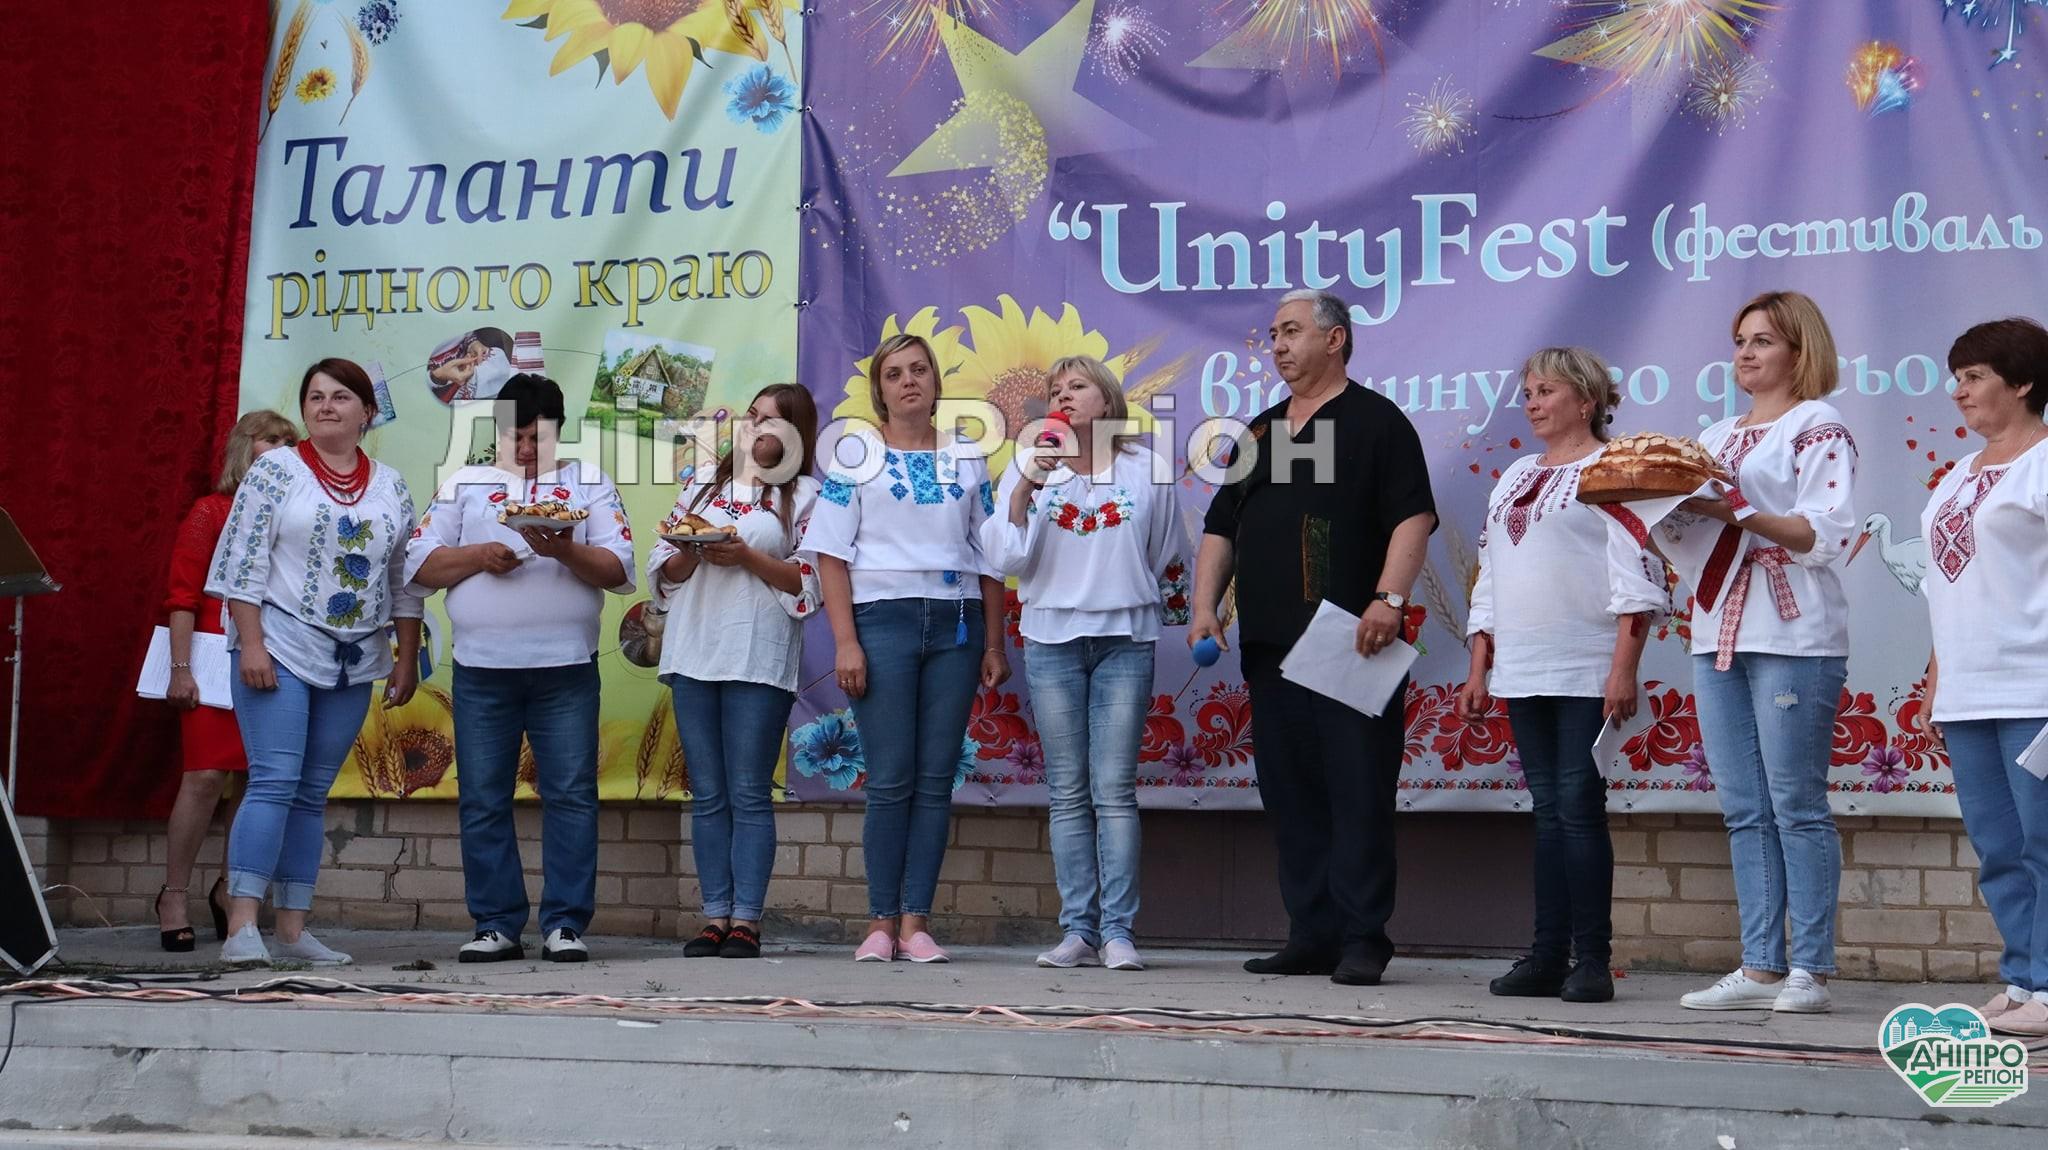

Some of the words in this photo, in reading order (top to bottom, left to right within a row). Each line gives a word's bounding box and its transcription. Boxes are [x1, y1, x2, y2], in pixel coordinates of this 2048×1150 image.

[284, 136, 738, 229] Таланти
[1652, 191, 2044, 281] (фестиваль
[265, 249, 552, 340] рідного
[573, 249, 773, 327] краю
